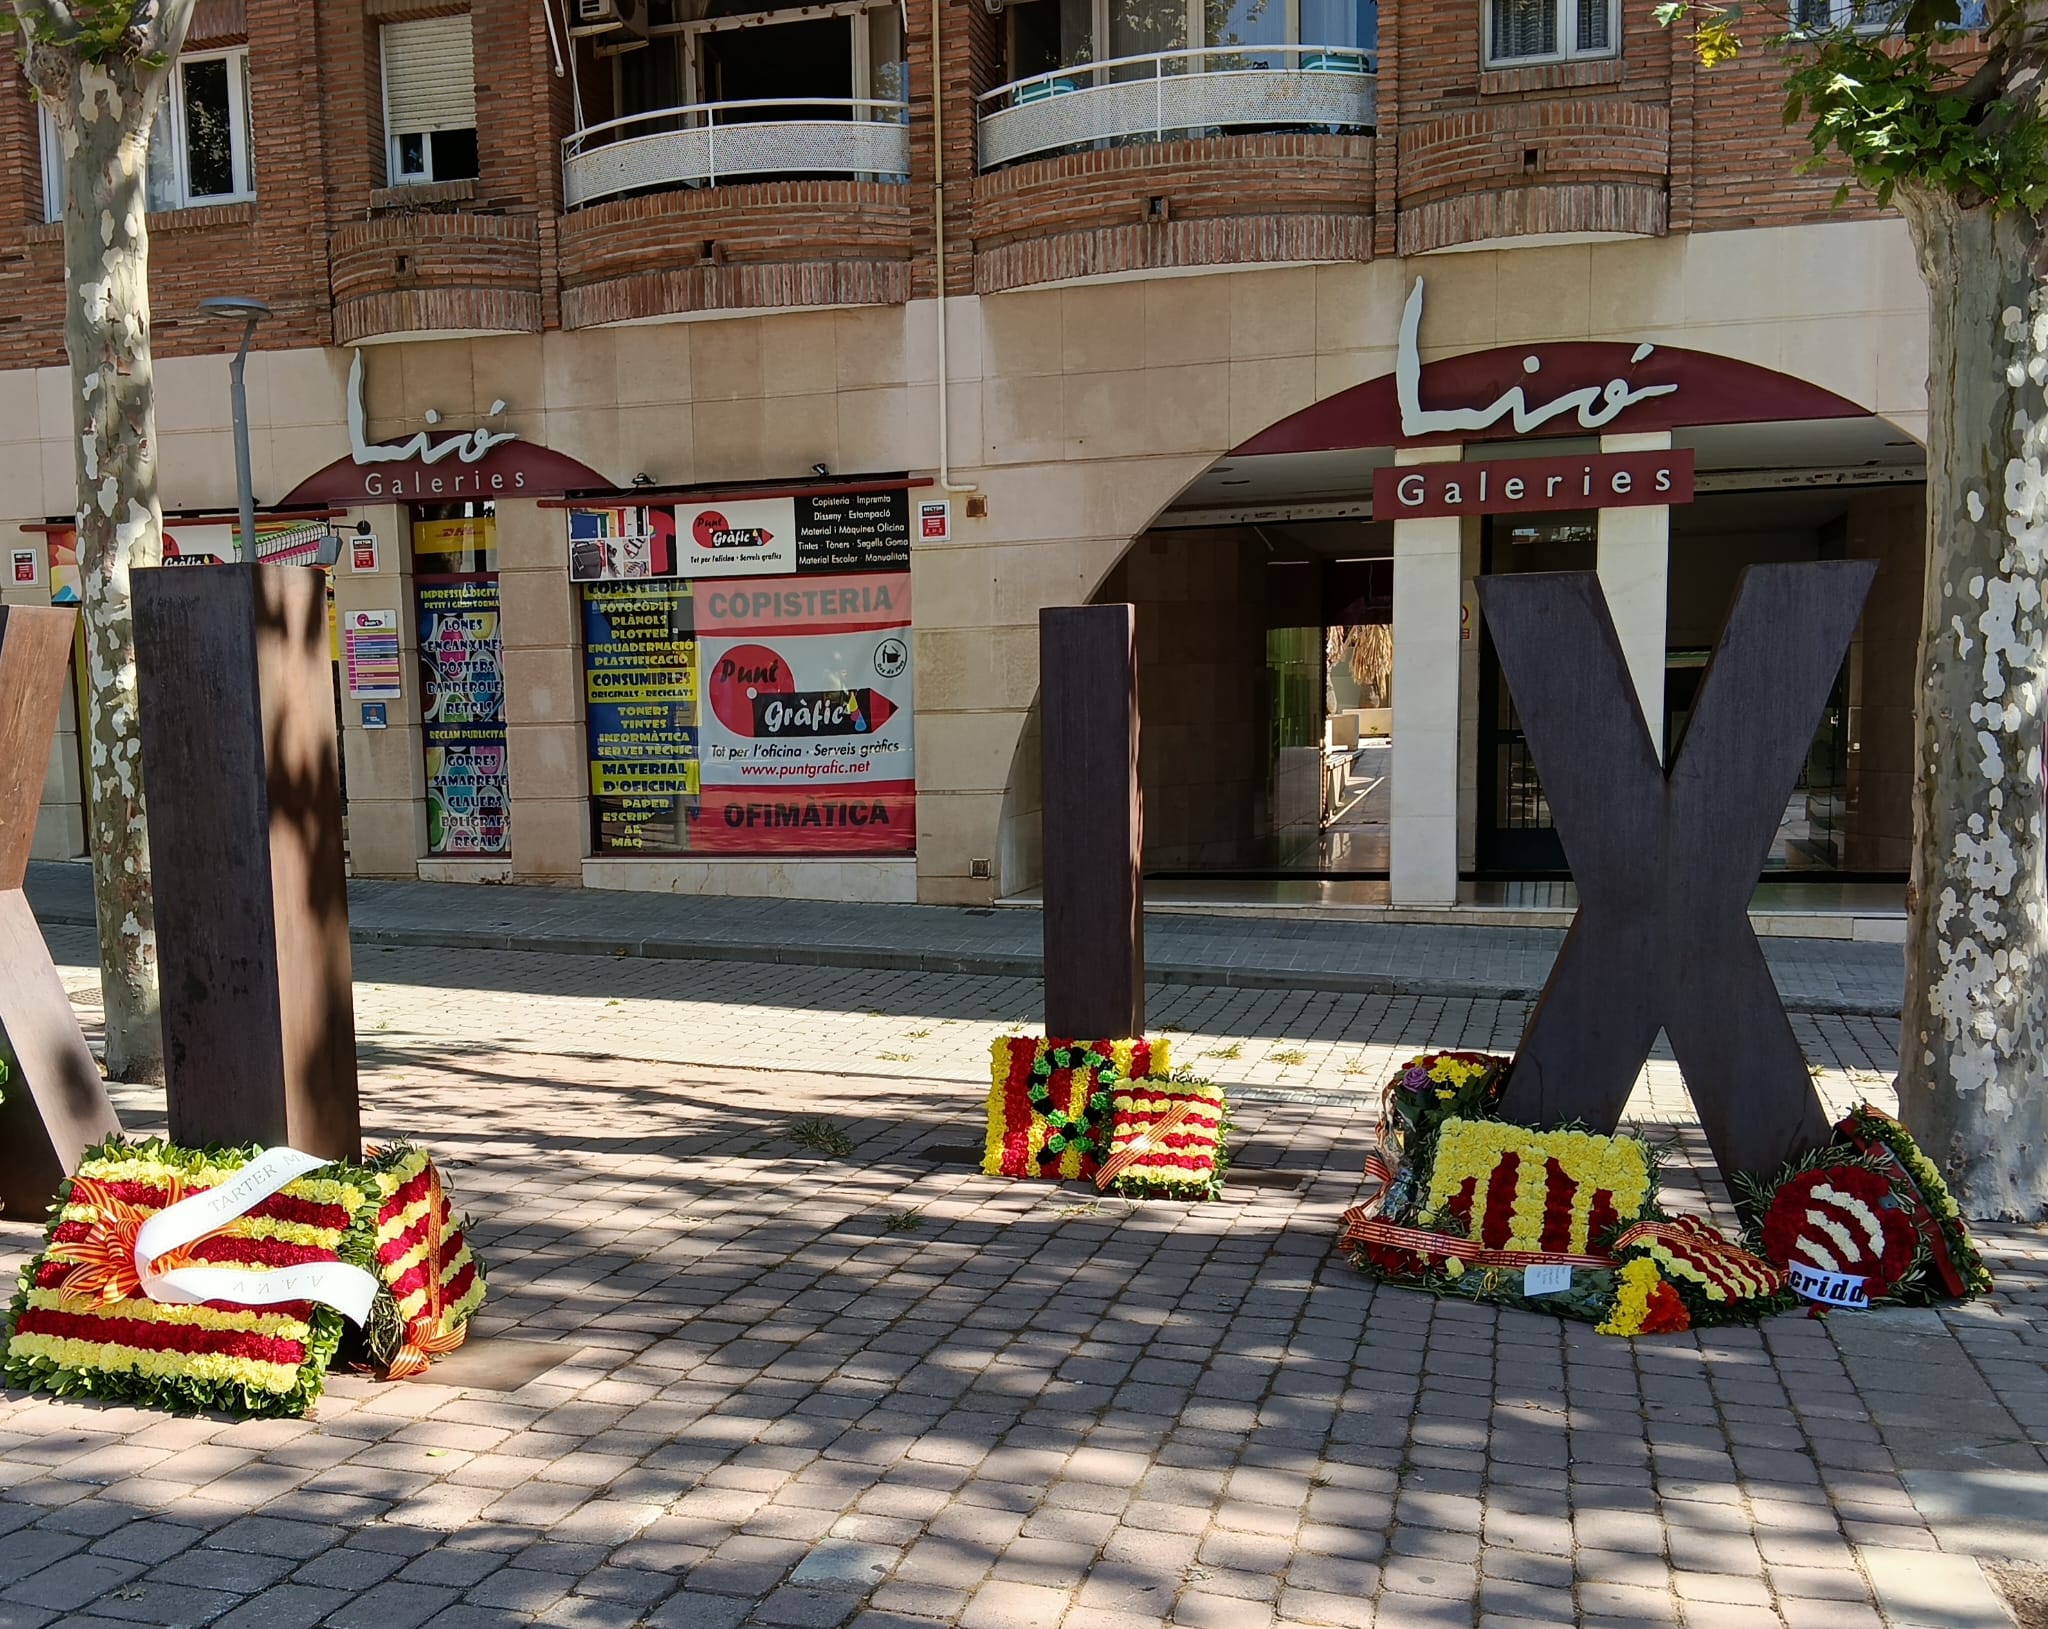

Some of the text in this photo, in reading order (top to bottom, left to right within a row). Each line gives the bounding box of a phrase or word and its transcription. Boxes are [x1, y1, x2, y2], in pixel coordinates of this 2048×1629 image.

[1395, 275, 1678, 437] Lió
[347, 347, 520, 465] Lió
[365, 470, 524, 496] Galeries
[1397, 466, 1671, 506] Galeries
[812, 496, 850, 507] Copisteria
[848, 509, 891, 520] Estampació
[801, 525, 832, 536] Material
[877, 522, 905, 533] Oficina
[712, 530, 750, 547] Gràfic
[797, 541, 819, 551] Tintes
[856, 538, 883, 549] Segells
[885, 537, 909, 547] Goma
[799, 552, 908, 565] Material Escolar Manualitats
[472, 588, 499, 598] DIGITA
[588, 581, 688, 594] COPISTERIA
[708, 585, 893, 619] COPISTERIA
[444, 618, 483, 630] LONES
[611, 628, 669, 639] PLOTTER
[588, 639, 694, 653] ENQUADERNACIÓ
[440, 660, 494, 672] POSTERS
[720, 658, 779, 683] Punt
[592, 671, 691, 686] CONSUMIBLES
[591, 689, 693, 698] ORIGINALS RECICLATS
[618, 705, 669, 716] TONERS
[764, 698, 844, 733] Gràfic
[620, 719, 667, 729] TINTES
[429, 730, 461, 739] RECLAM
[597, 746, 643, 756] SERVEI
[711, 739, 899, 760] Tot per l'oficina Serveis gràfics
[448, 755, 496, 767] GORRES
[602, 763, 687, 775] MATERIAL
[741, 760, 870, 779] www.puntgrafic.net
[433, 775, 508, 786] SAMARRETE
[603, 780, 687, 792] D'OFICINA
[448, 796, 502, 807] CLAUERS
[622, 799, 669, 808] PAPER
[724, 796, 889, 828] OFIMÀTICA
[454, 836, 500, 847] REGALS
[208, 1164, 278, 1211] TARTER
